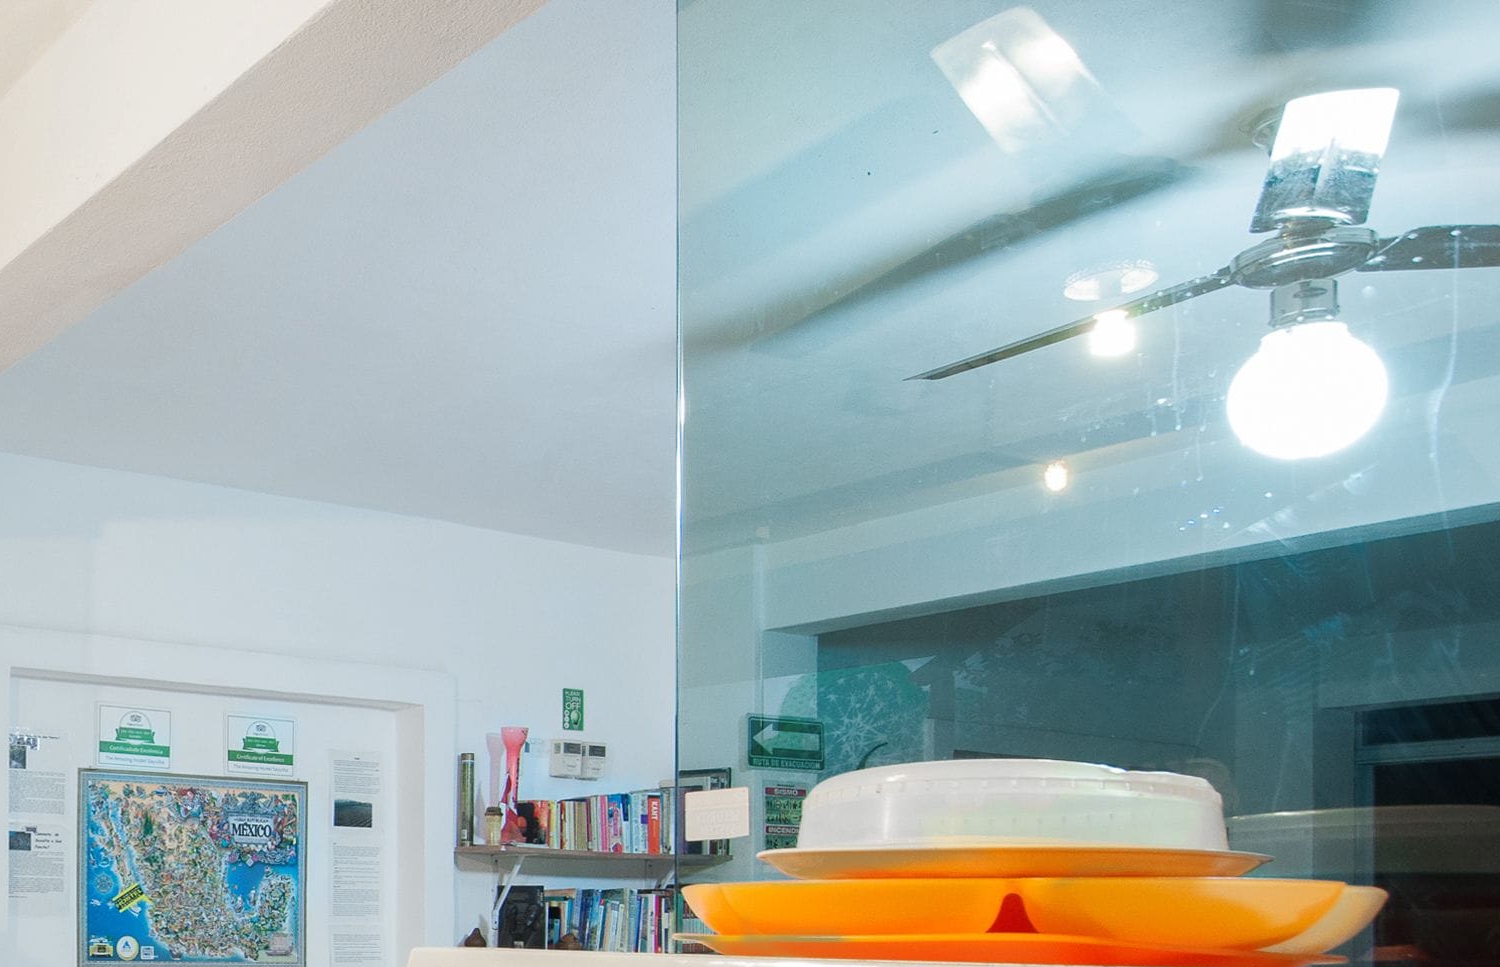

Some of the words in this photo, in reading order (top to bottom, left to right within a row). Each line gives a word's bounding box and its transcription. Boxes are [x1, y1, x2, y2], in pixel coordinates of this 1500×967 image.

[770, 759, 779, 767] DE
[773, 787, 798, 796] SISMO
[651, 801, 659, 821] KANT
